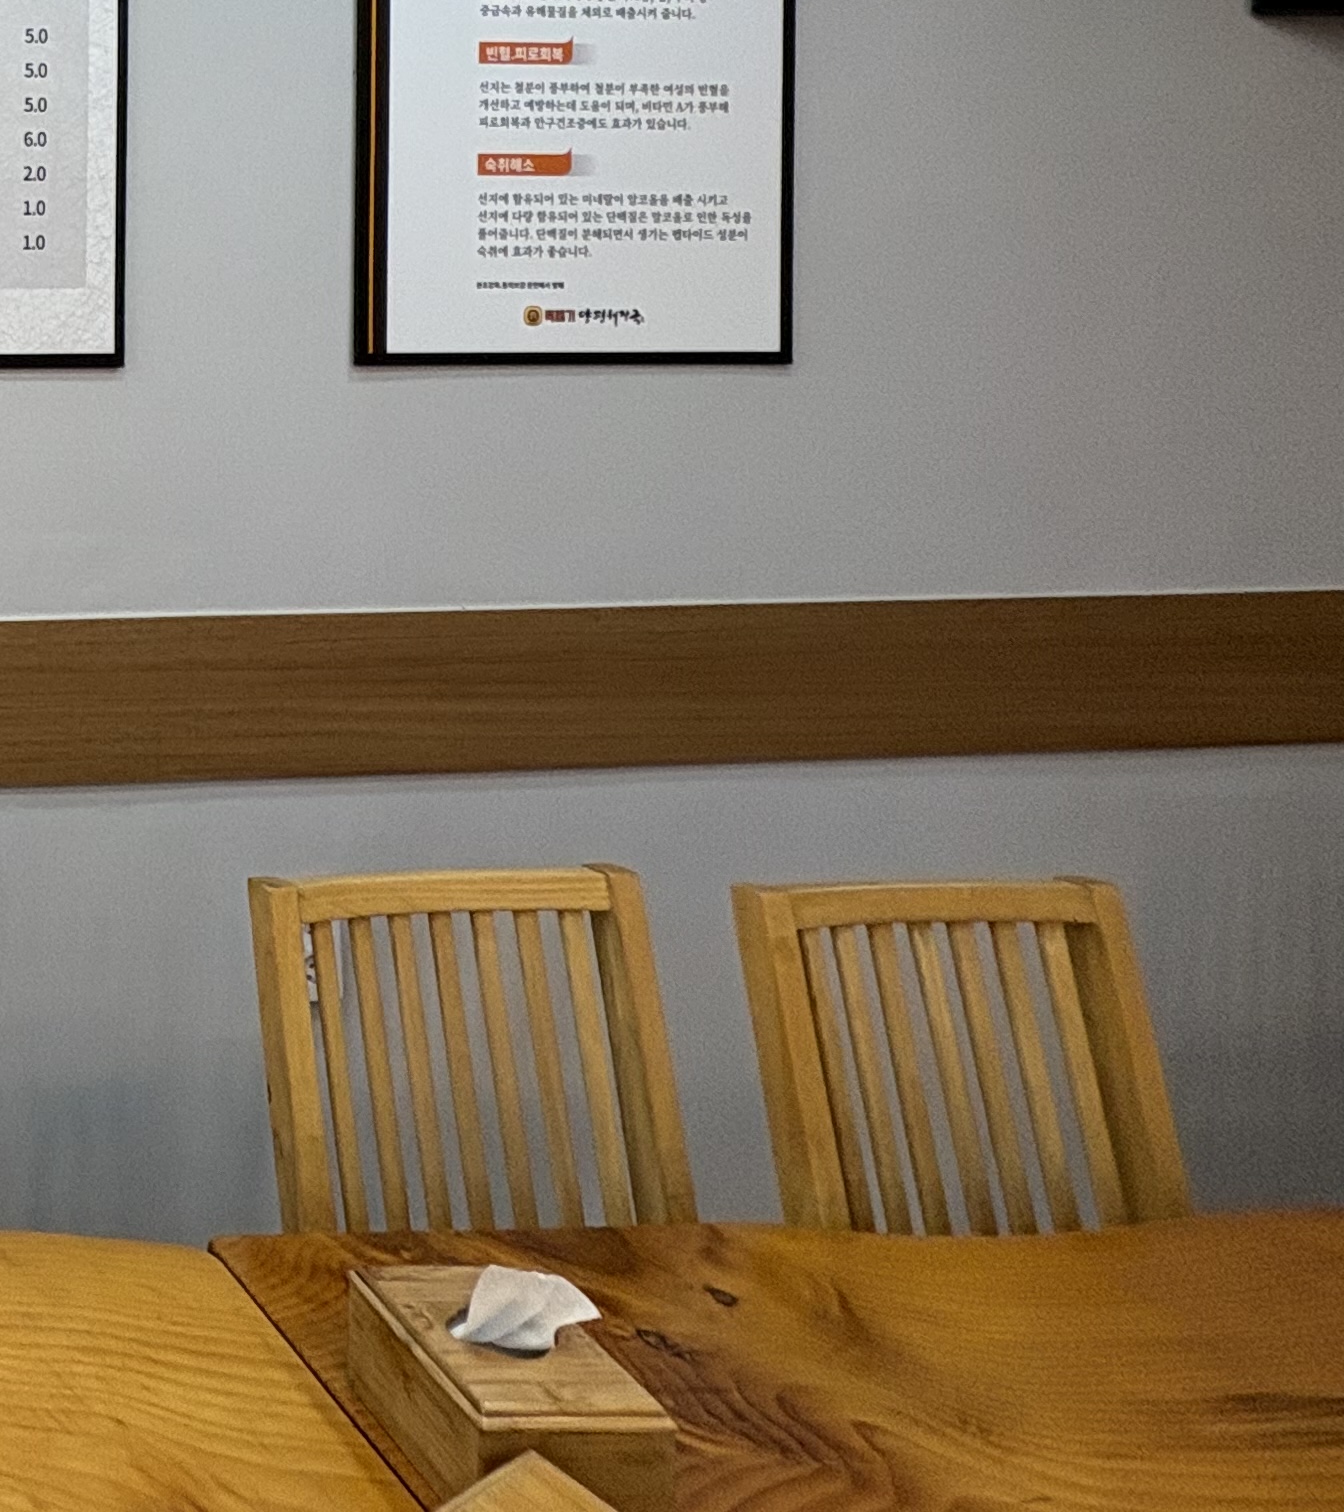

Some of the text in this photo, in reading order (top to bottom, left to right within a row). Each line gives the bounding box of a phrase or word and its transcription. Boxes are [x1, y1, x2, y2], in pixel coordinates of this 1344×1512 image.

[24, 27, 49, 45] 5.0
[23, 62, 48, 79] 5.0
[23, 97, 48, 113] 5.0
[23, 131, 48, 148] 6.0
[23, 165, 47, 182] 2.0
[484, 157, 536, 173] 숙취해소
[23, 199, 46, 217] 1.0
[22, 234, 46, 251] 1.0
